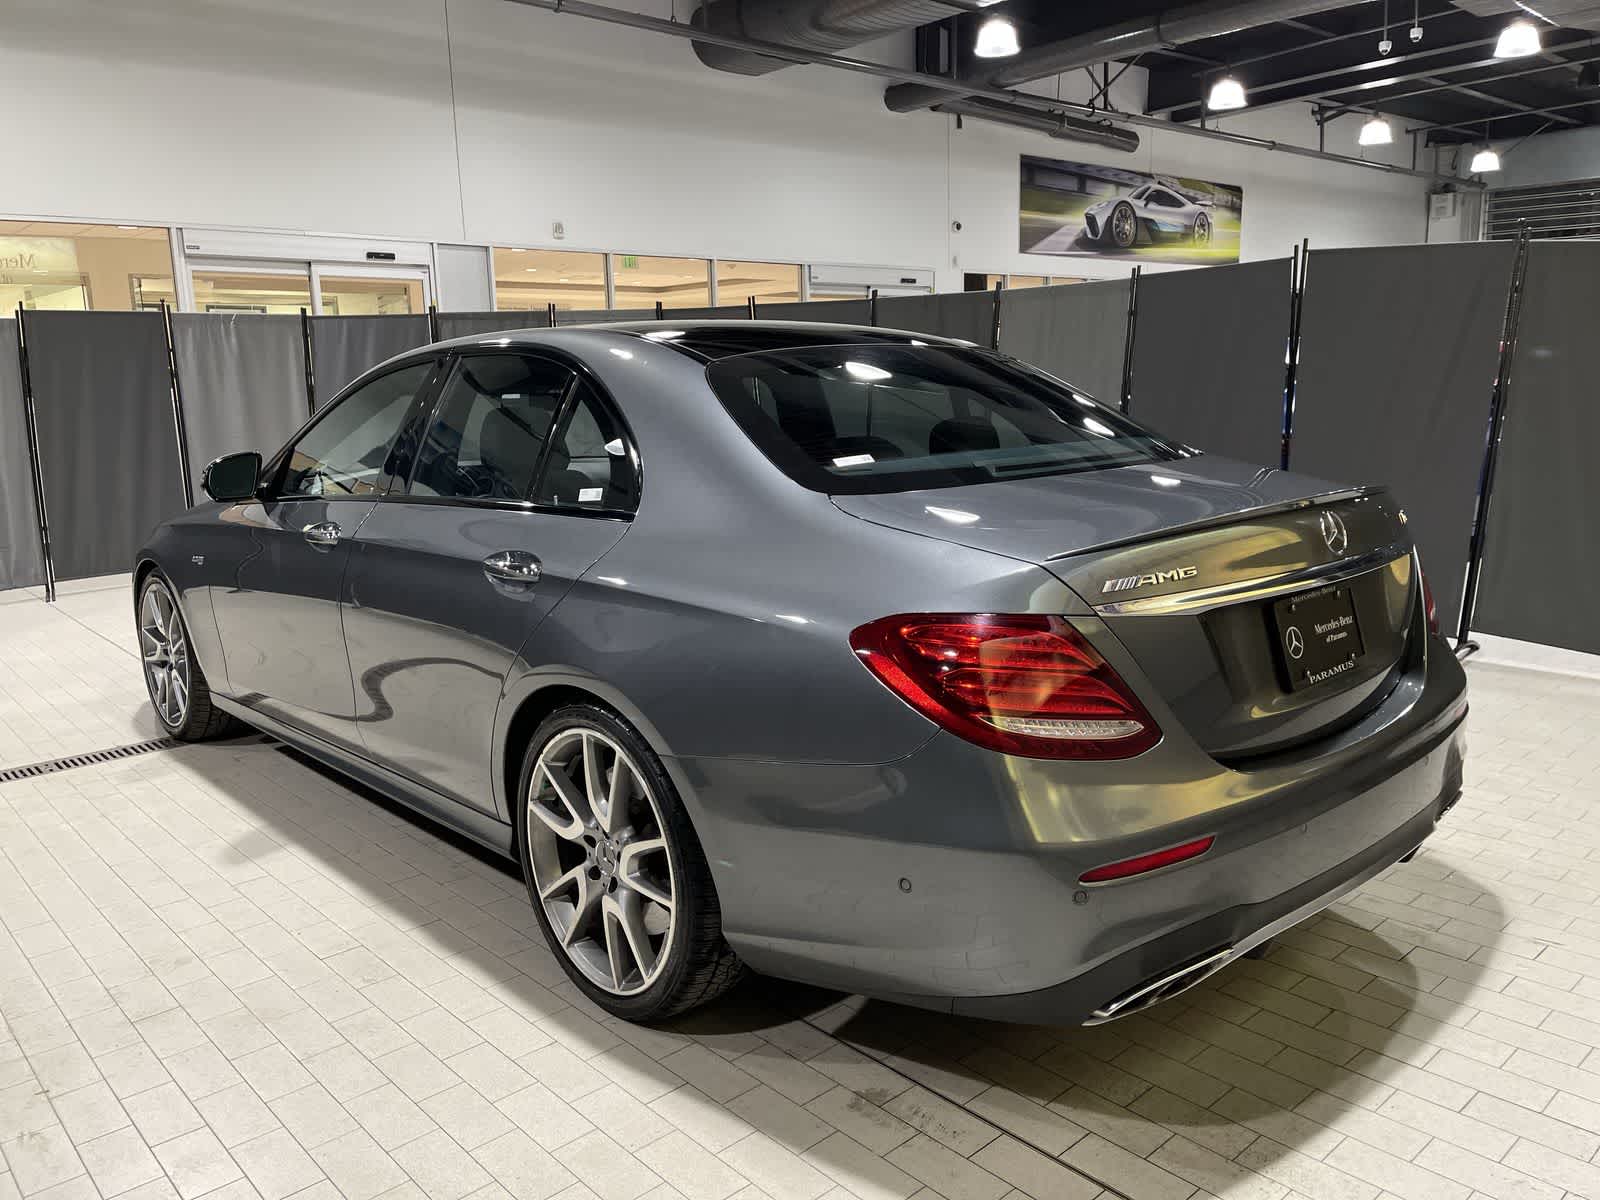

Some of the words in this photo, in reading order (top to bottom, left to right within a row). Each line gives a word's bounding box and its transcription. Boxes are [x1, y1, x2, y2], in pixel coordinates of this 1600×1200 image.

[1135, 566, 1198, 588] AMG
[1314, 615, 1353, 634] Mercedes-Benz
[1309, 660, 1354, 684] PARAMUS
